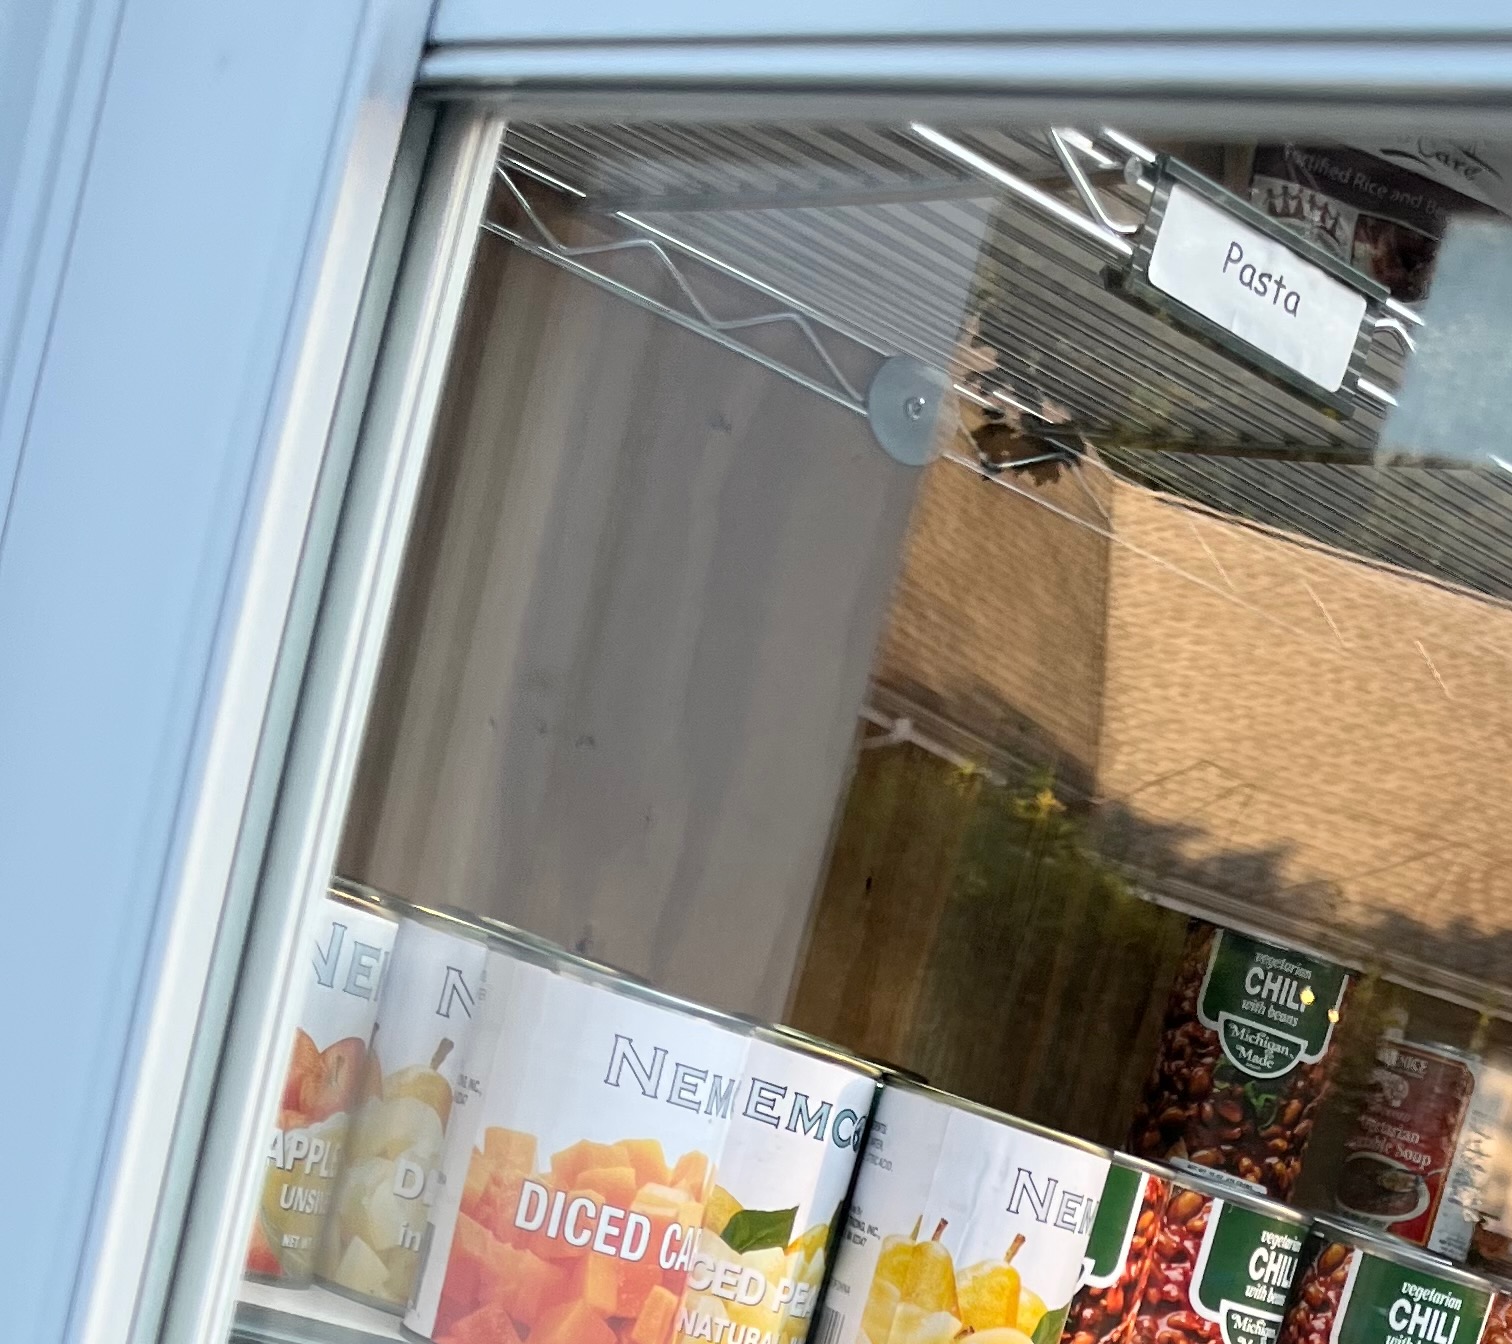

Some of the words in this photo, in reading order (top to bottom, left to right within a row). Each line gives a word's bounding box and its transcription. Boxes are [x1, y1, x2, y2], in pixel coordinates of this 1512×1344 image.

[1352, 172, 1389, 201] Rice
[1222, 241, 1301, 318] Pasta
[1254, 952, 1313, 980] vegetarian
[1241, 999, 1266, 1016] with
[1267, 1006, 1299, 1027] beans
[1228, 1023, 1290, 1056] Michigan
[1236, 1045, 1275, 1069] Made
[514, 1178, 652, 1263] DICED
[1244, 1282, 1267, 1302] with
[1401, 1280, 1463, 1312] vegetarian
